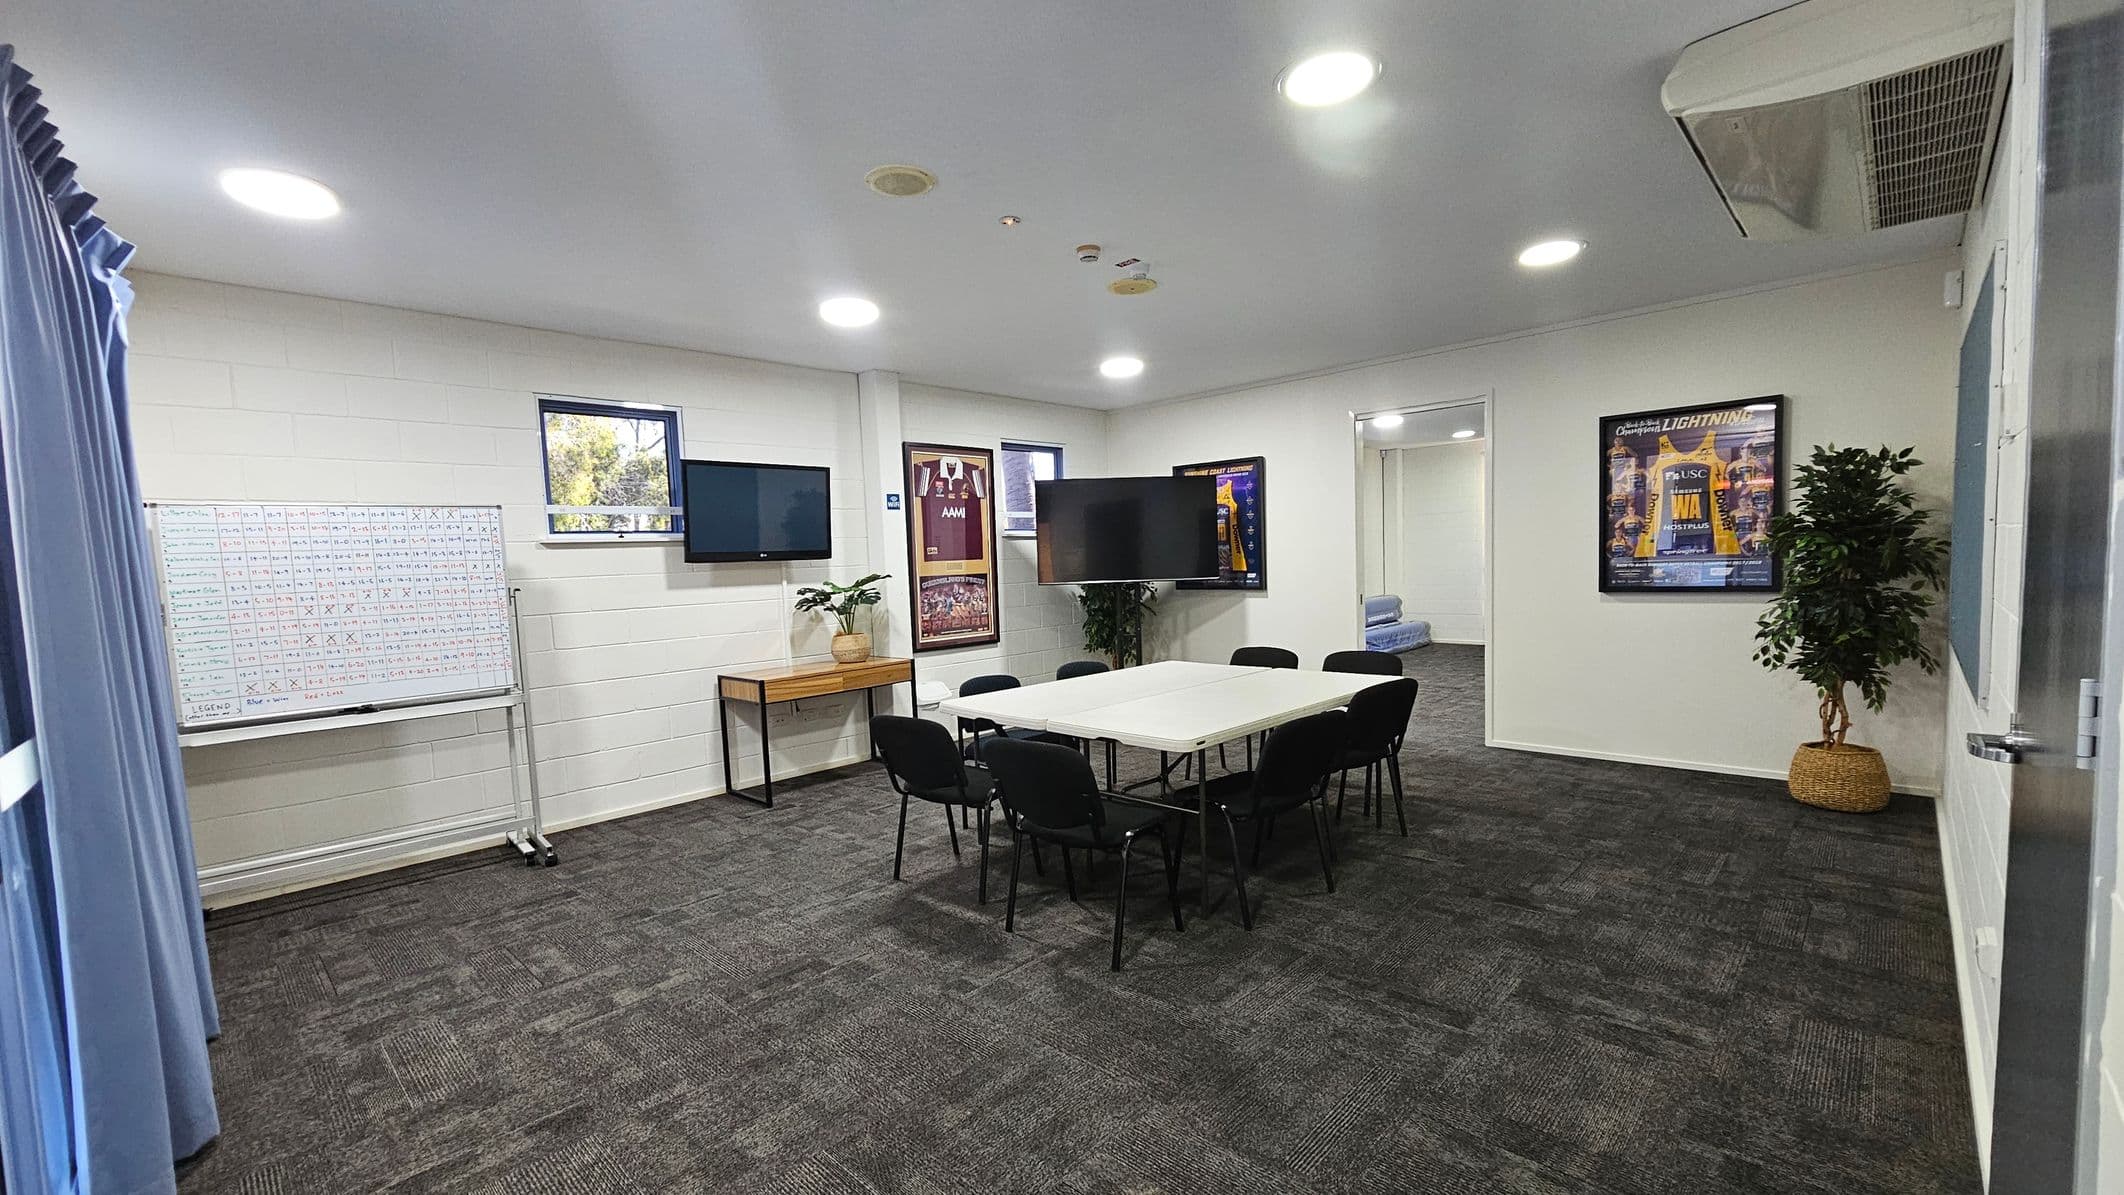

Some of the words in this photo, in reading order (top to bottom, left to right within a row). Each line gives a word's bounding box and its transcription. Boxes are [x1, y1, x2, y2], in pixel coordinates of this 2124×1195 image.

[1661, 409, 1753, 433] LIGHTNING
[1681, 469, 1708, 479] USC
[941, 506, 966, 519] AAMI
[1671, 493, 1702, 520] WA
[1663, 522, 1710, 531] HOSTPLUS
[191, 702, 231, 714] LEGEND
